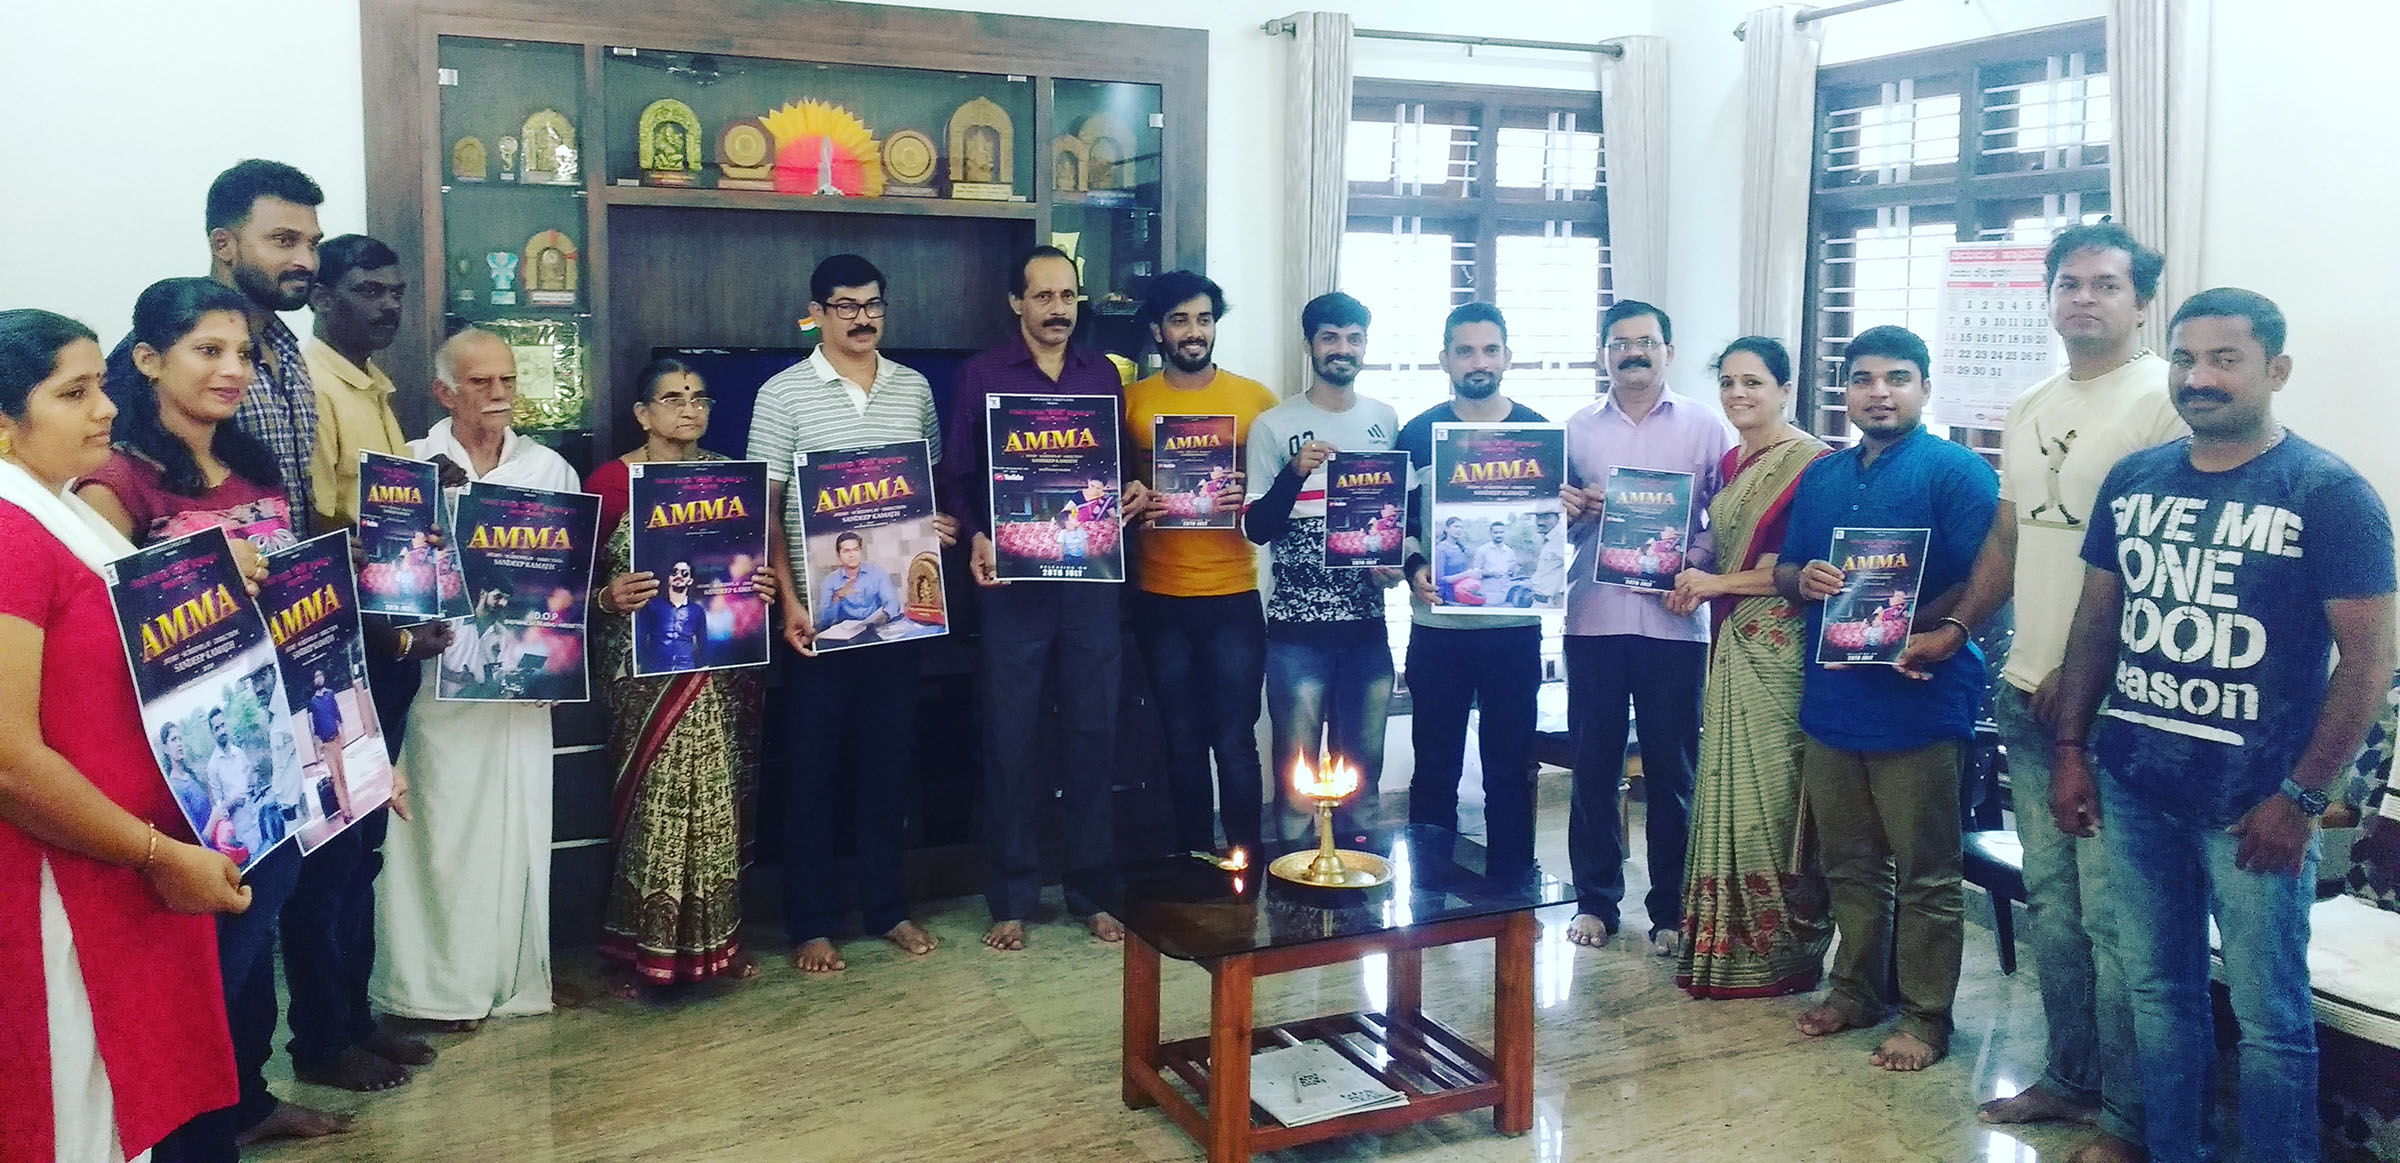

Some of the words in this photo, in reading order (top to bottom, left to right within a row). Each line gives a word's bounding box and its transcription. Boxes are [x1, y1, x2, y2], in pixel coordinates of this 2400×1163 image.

[1967, 300, 1972, 309] 1
[1981, 300, 1989, 310] 2
[1997, 301, 2005, 310] 3
[2011, 301, 2017, 310] 4
[2026, 301, 2032, 310] 5
[2040, 301, 2046, 310] 6
[1964, 317, 1971, 325] 8
[1980, 317, 1987, 326] 9
[1994, 317, 2006, 326] 10
[2008, 318, 2018, 327] 11
[2023, 318, 2033, 327] 12
[2037, 318, 2048, 327] 13
[1960, 333, 1972, 342] 15
[1976, 334, 1989, 342] 16
[1992, 334, 2004, 343] 17
[2008, 335, 2018, 343] 18
[2022, 335, 2033, 344] 19
[2036, 335, 2048, 344] 20
[1958, 349, 1971, 358] 22
[1975, 350, 1987, 359] 23
[1990, 351, 2003, 360] 24
[2005, 351, 2017, 360] 25
[2020, 352, 2032, 360] 26
[2034, 352, 2047, 361] 27
[1957, 365, 1970, 375] 29
[1972, 366, 1986, 376] 30
[1989, 367, 2002, 376] 31
[1003, 427, 1100, 453] AMMA
[1164, 433, 1221, 451] AMMA
[1336, 471, 1393, 488] AMMA
[1449, 458, 1545, 484] AMMA
[367, 484, 423, 504] AMMA
[815, 475, 914, 513] AMMA
[1615, 492, 1677, 504] AMMA
[646, 496, 749, 529] AMMA
[466, 525, 573, 549] AMMA
[2212, 501, 2303, 557] ME
[1841, 553, 1909, 571] AMMA
[2118, 537, 2244, 609] ONE
[142, 583, 241, 663] AMMA
[270, 583, 342, 647] AMMA
